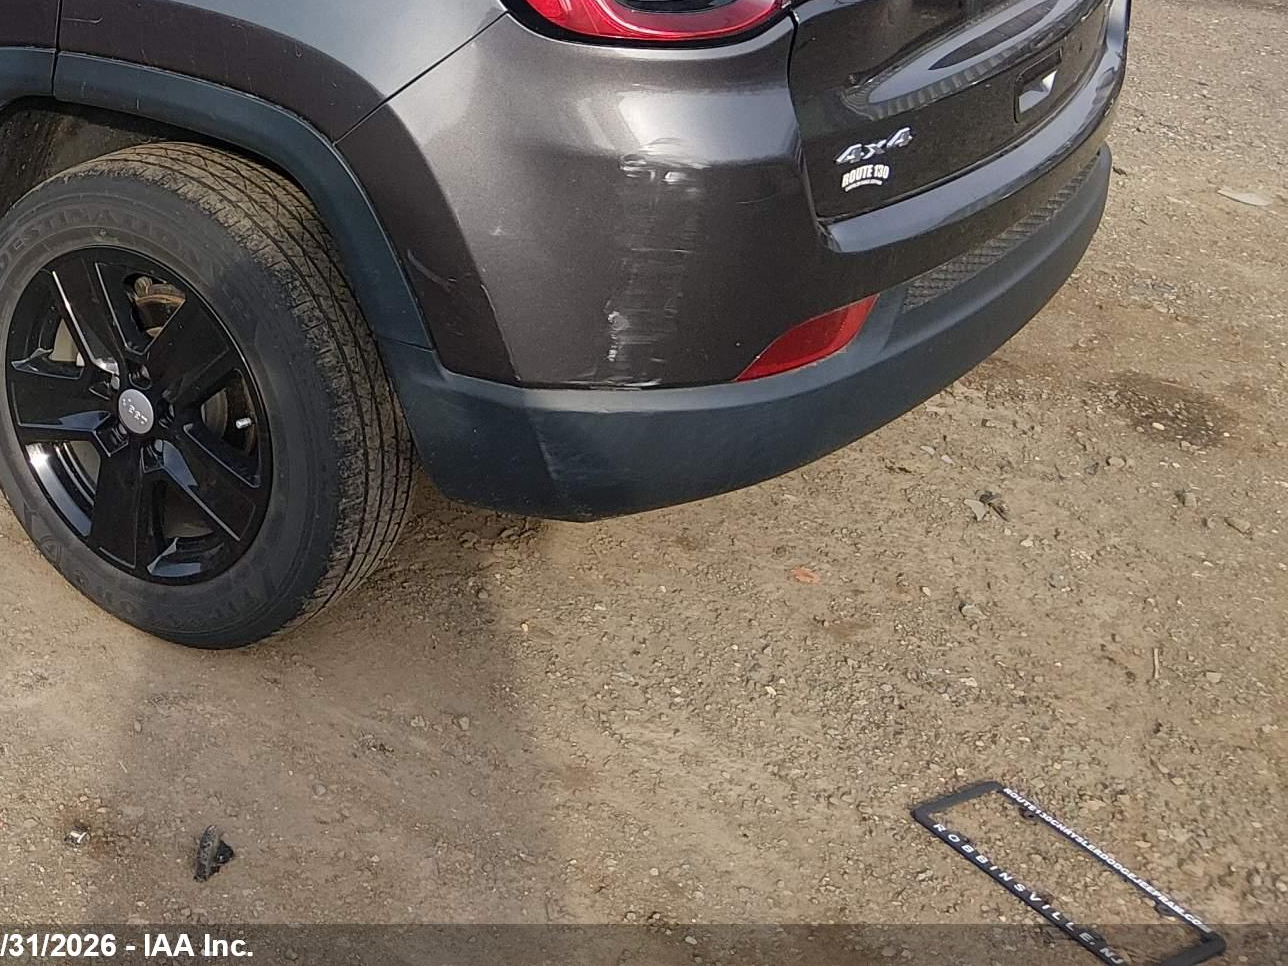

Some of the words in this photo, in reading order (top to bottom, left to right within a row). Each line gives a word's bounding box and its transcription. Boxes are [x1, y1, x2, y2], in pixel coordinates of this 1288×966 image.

[841, 164, 874, 187] ROUTE
[874, 164, 890, 179] 130
[932, 823, 1097, 946] ROBBINSVILLE,
[1099, 947, 1125, 964] NJ
